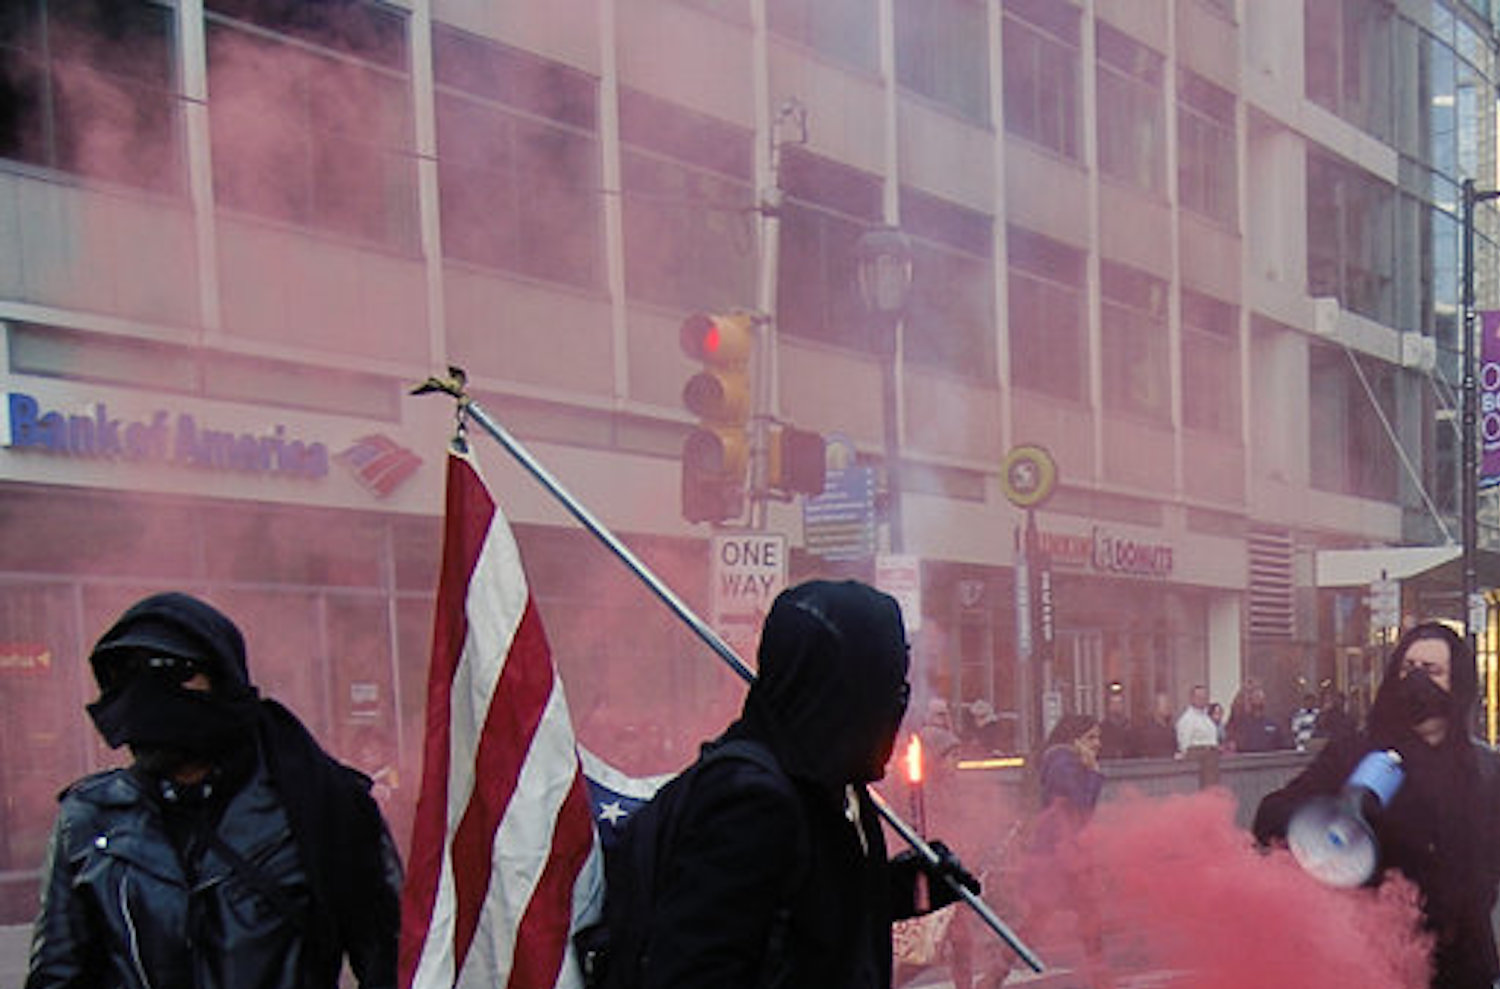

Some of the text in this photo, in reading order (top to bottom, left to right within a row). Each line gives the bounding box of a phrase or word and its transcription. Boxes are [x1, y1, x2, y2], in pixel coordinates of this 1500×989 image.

[8, 392, 119, 456] Bank
[176, 413, 328, 478] America
[721, 541, 777, 567] ONE
[721, 573, 775, 598] WAY
